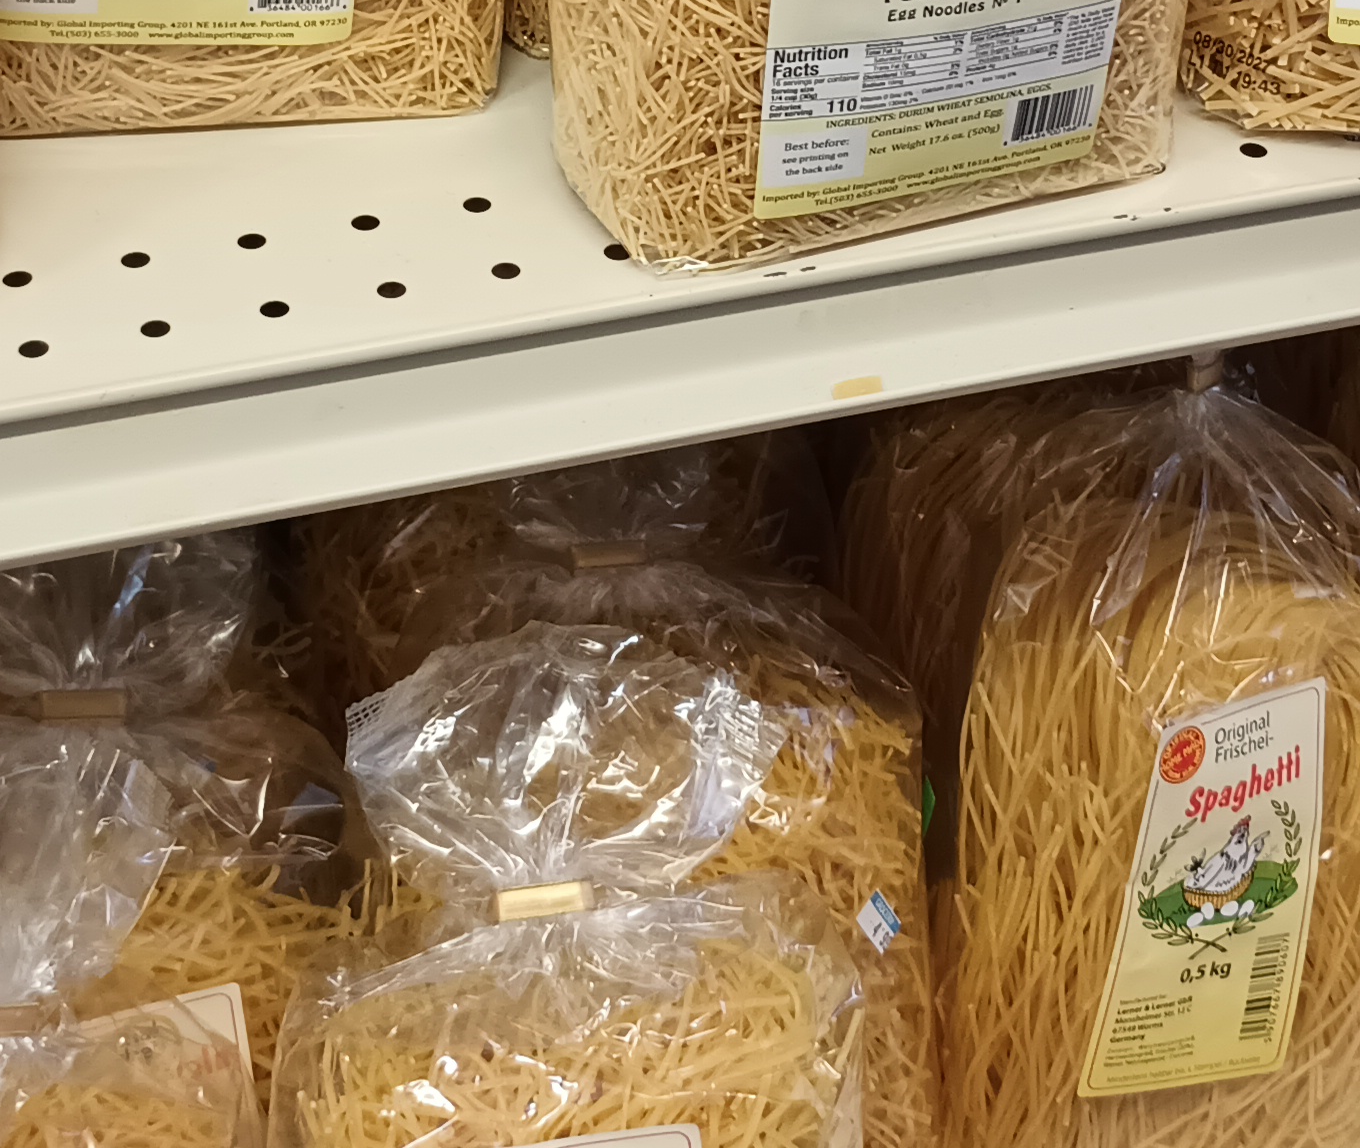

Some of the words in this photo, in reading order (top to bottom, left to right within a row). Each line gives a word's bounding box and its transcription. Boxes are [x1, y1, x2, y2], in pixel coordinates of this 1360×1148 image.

[887, 8, 917, 23] Egg
[922, 0, 985, 19] Noodles
[773, 47, 849, 63] Nutrition
[773, 64, 819, 78] Facts
[827, 98, 858, 113] 110
[826, 113, 896, 128] INGREDIENTS:
[871, 125, 922, 138] Contains:
[925, 115, 958, 130] Wheat
[961, 113, 981, 123] and
[784, 142, 808, 152] Best
[869, 147, 886, 155] Net
[892, 140, 926, 152] Weight
[929, 133, 952, 147] 17.6
[1214, 711, 1270, 745] Original
[1214, 735, 1274, 764] Frischei-
[1184, 744, 1300, 822] Spaghetti
[1180, 964, 1205, 983] 0,5
[1210, 961, 1232, 978] kg
